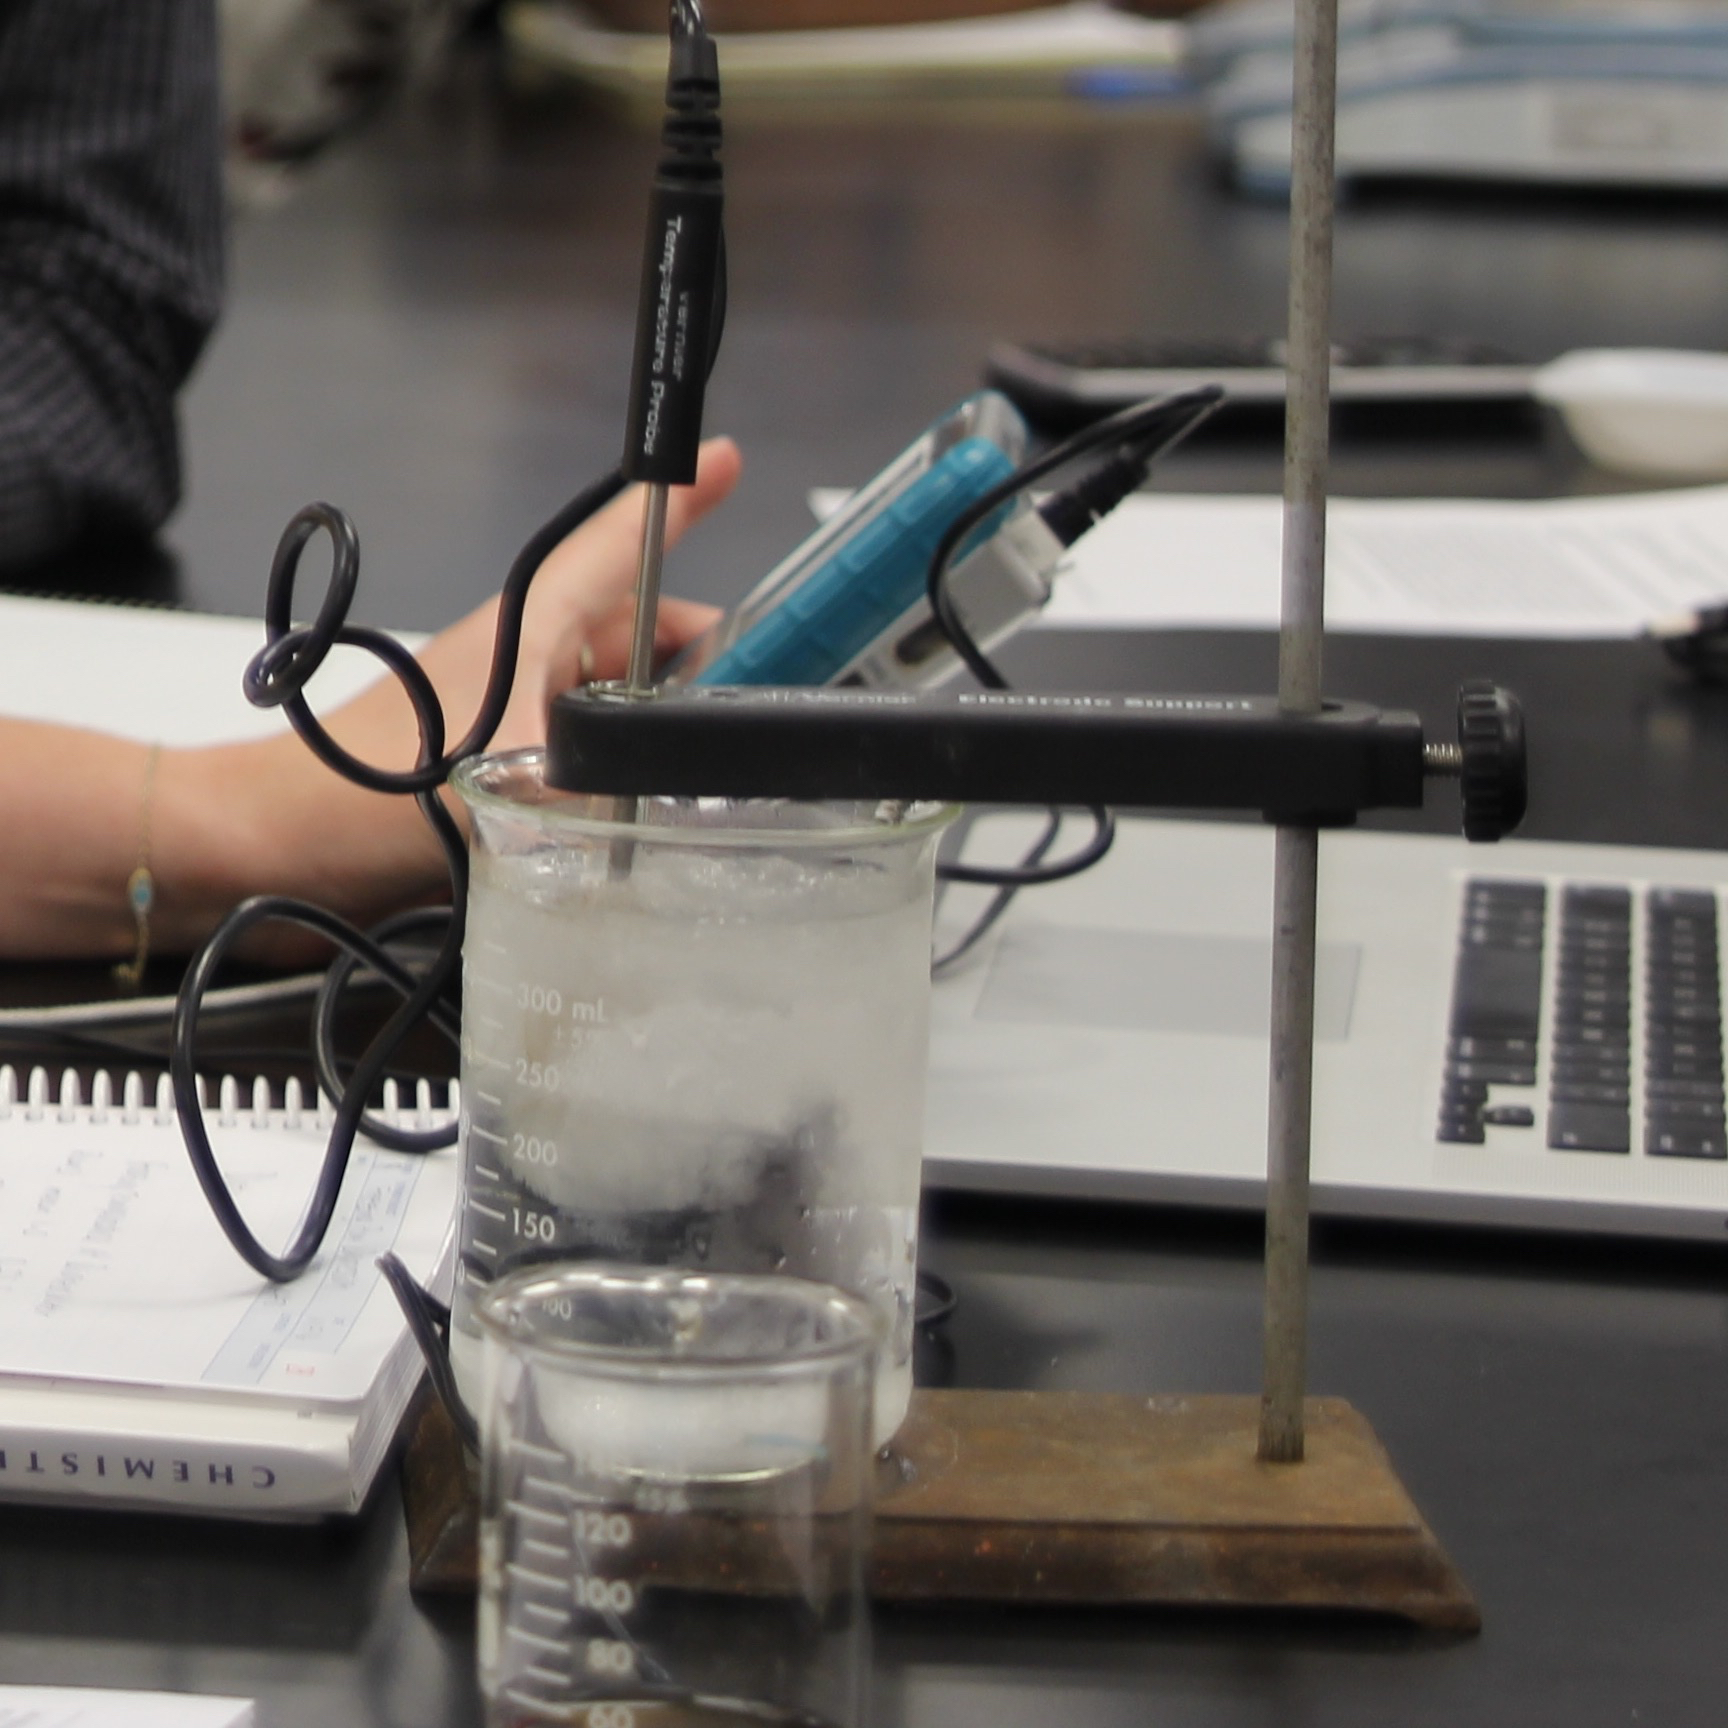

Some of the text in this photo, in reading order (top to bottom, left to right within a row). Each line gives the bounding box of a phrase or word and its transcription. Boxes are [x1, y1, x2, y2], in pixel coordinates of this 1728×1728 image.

[643, 214, 683, 456] Temperature Probe
[516, 982, 563, 1017] 300
[515, 1057, 560, 1092] 250
[513, 1133, 558, 1167] 200
[512, 1207, 556, 1244] 150
[572, 1508, 633, 1548] 120
[573, 1574, 634, 1615] 100
[586, 1637, 634, 1676] 80
